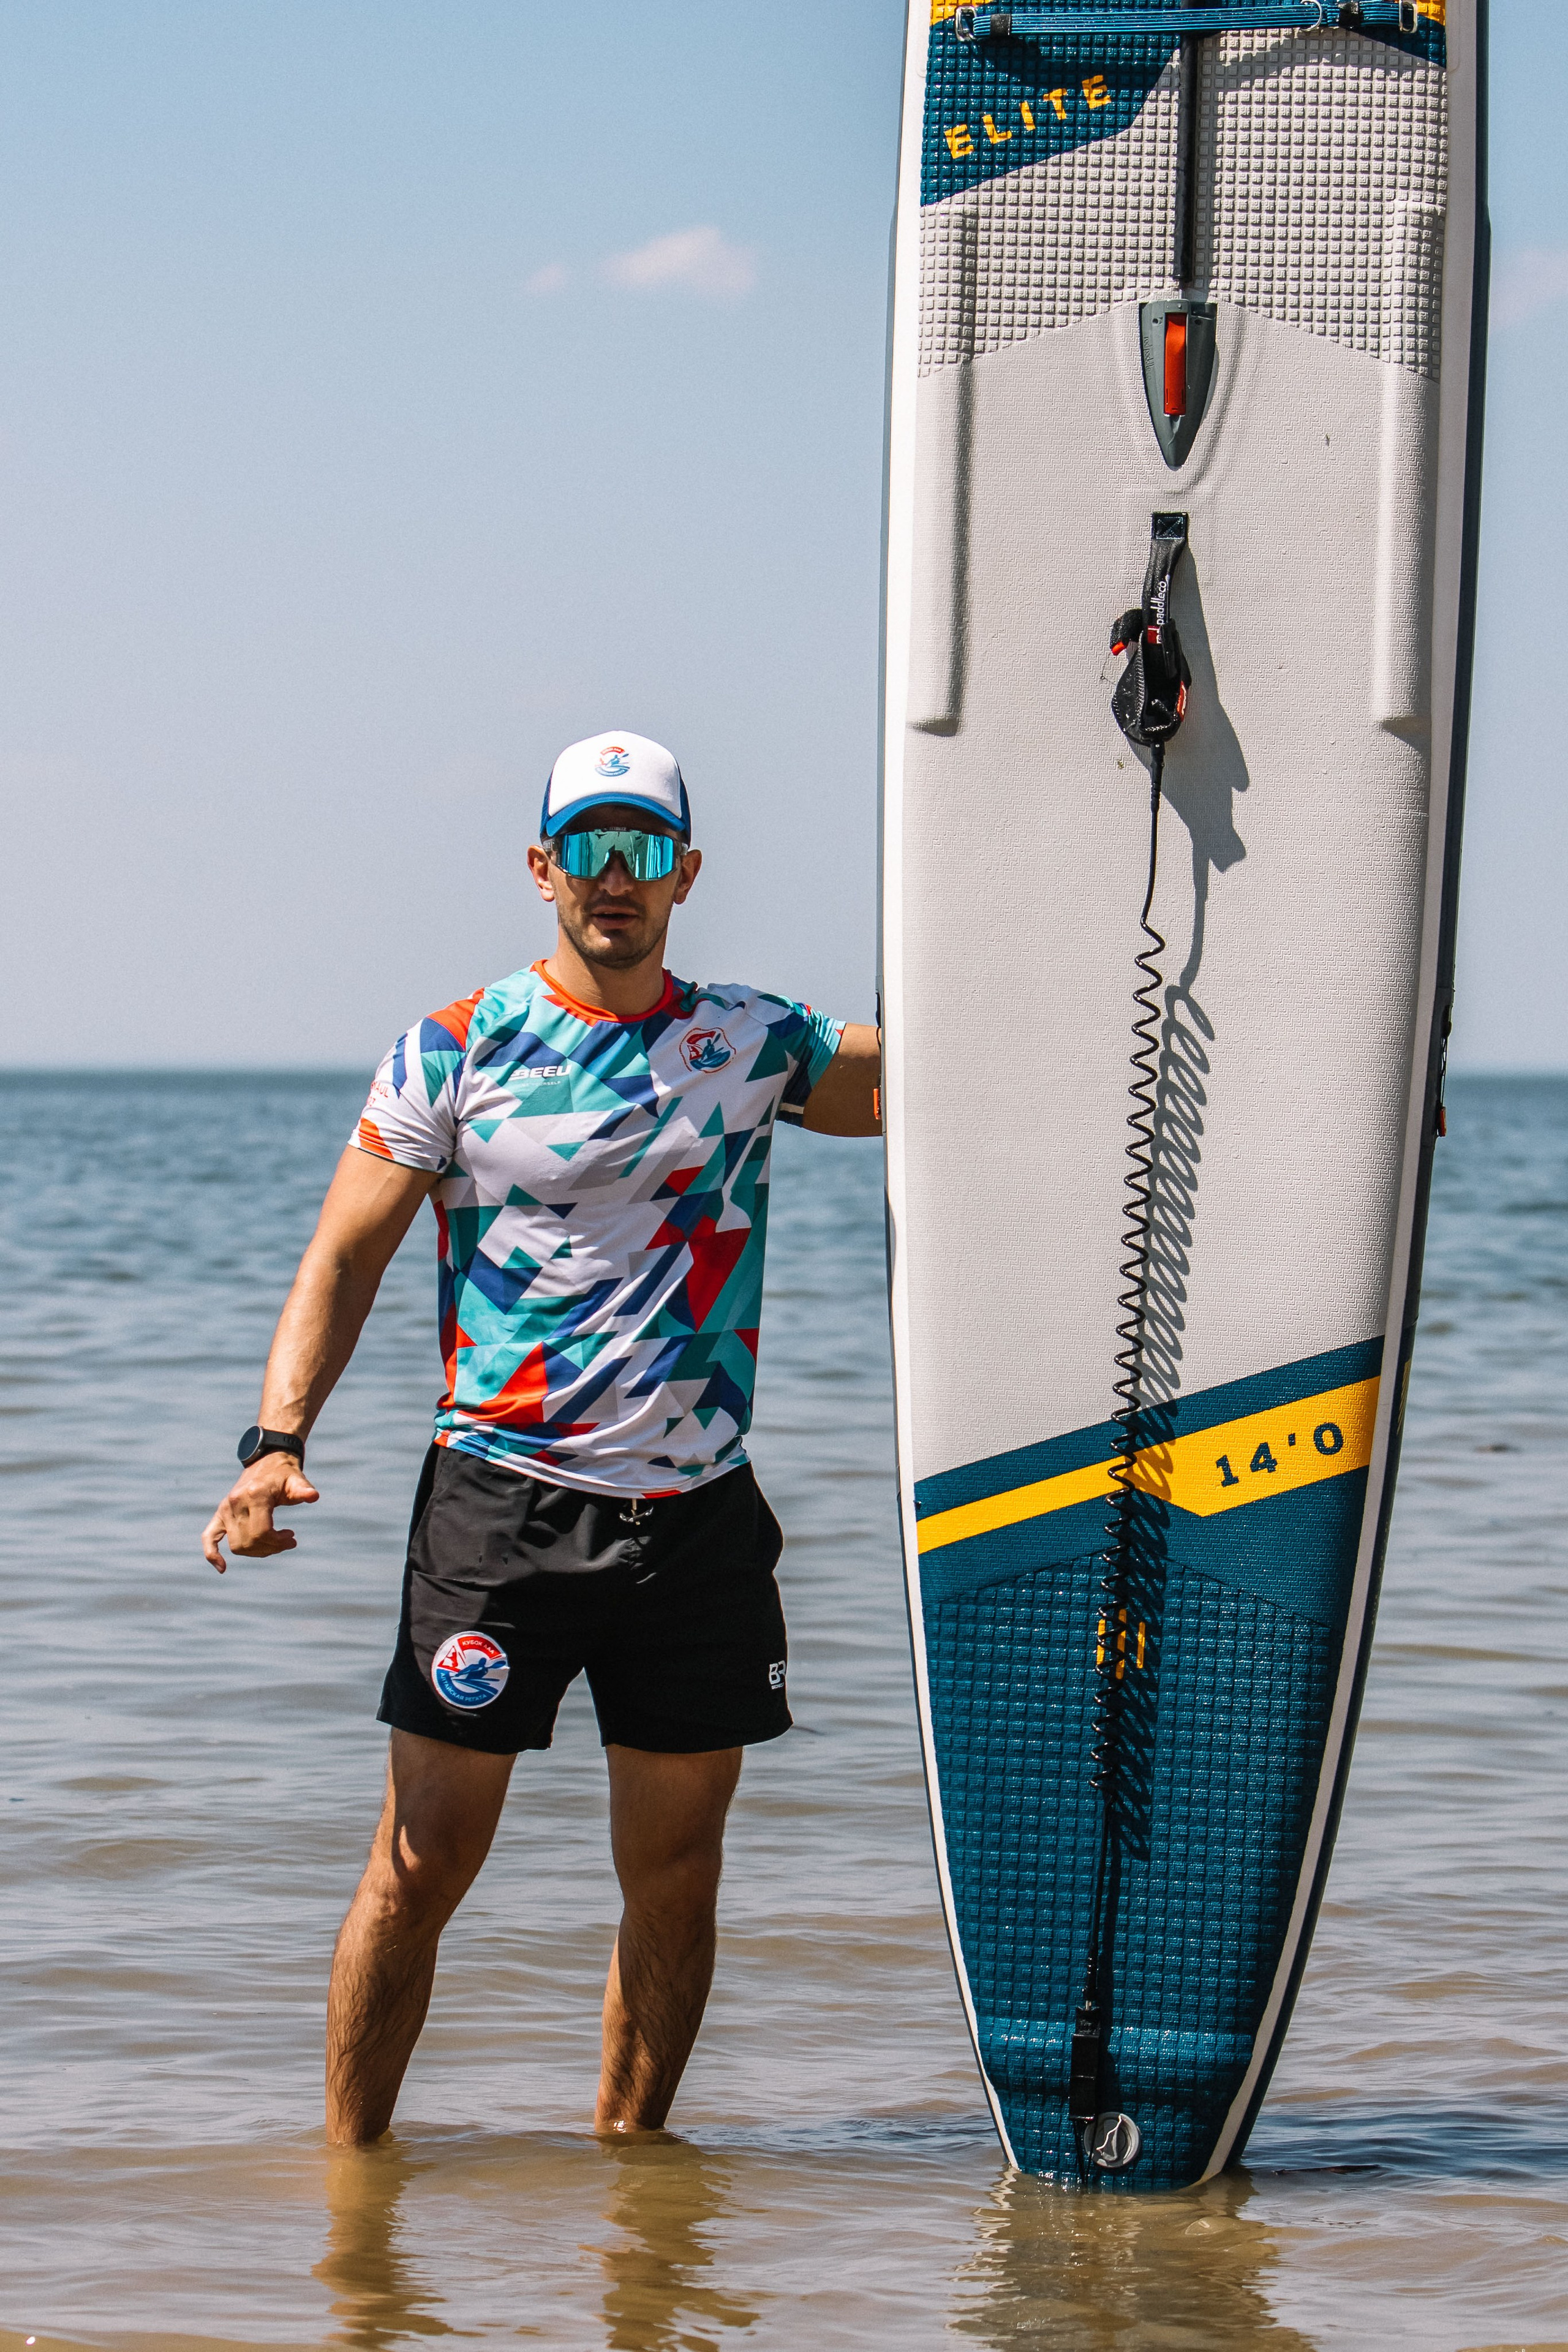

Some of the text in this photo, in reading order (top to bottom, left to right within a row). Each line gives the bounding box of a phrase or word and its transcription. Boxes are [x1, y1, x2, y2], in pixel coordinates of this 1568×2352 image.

[944, 75, 1112, 159] ELITE
[1215, 1422, 1344, 1488] 14'0
[440, 1672, 464, 1700] АЛТАЙСКАЯ
